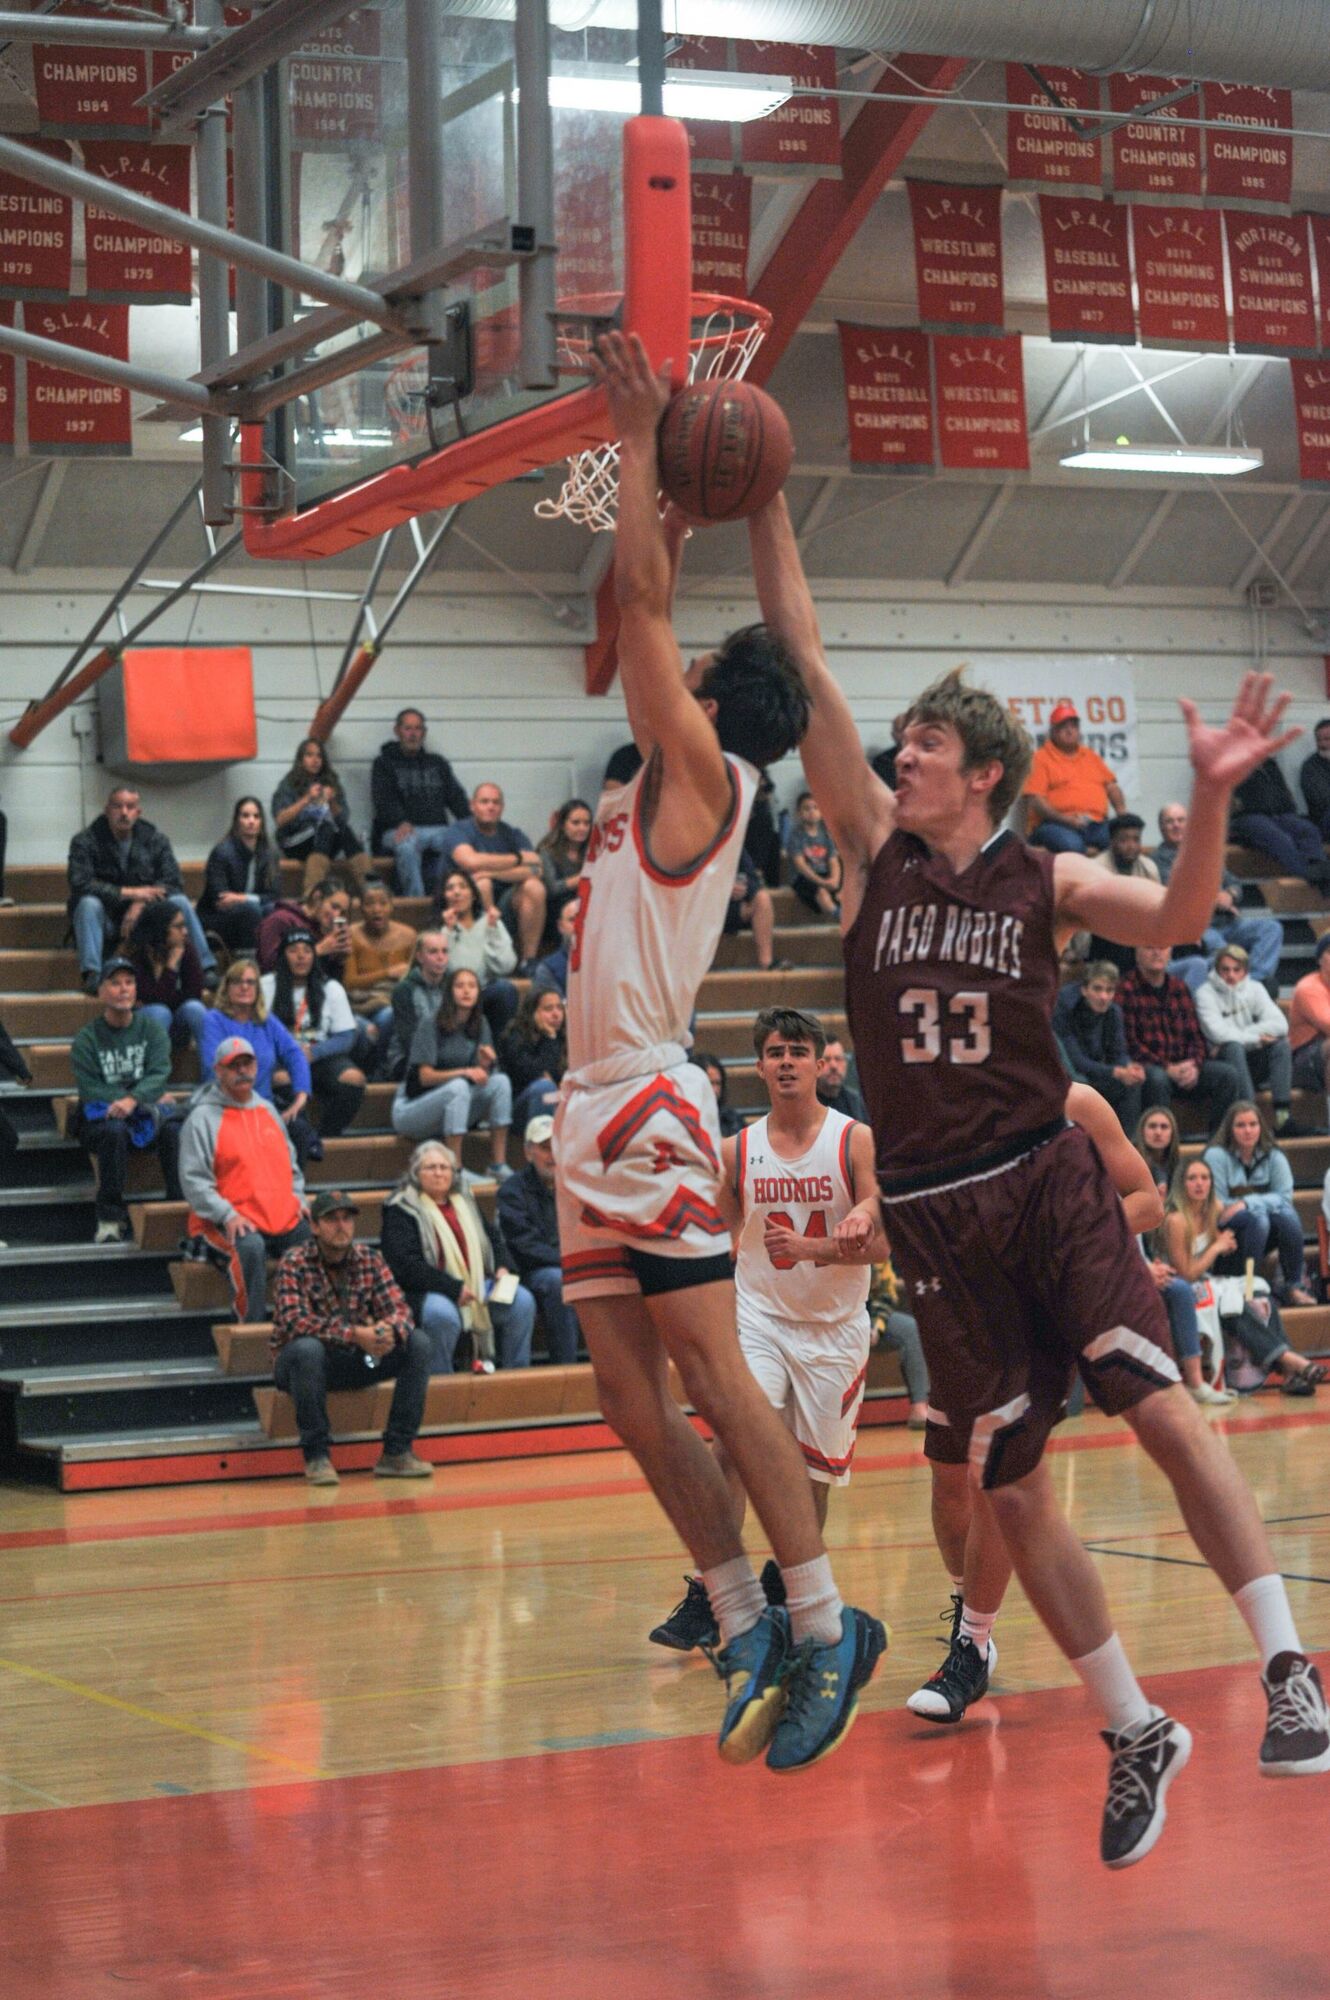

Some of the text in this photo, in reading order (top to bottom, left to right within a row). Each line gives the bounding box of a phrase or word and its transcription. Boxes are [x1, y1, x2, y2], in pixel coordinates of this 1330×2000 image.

[43, 62, 138, 84] CHAMPIONS
[290, 63, 363, 83] COUNTRY
[77, 100, 109, 113] 1984
[766, 108, 832, 125] AMPIONS
[1127, 123, 1187, 143] COUNTRY
[1016, 137, 1096, 158] CHAMPIONS
[1213, 142, 1288, 166] CHAMPIONS
[1120, 147, 1196, 169] CHAMPIONS
[1149, 174, 1175, 187] 1985
[1242, 176, 1266, 189] 1985
[0, 195, 64, 215] ESTLING
[0, 229, 65, 249] AMPIONS
[93, 234, 184, 255] CHAMPIONS
[920, 237, 997, 258] WRESTLING
[1234, 226, 1303, 257] NORTHERN
[1054, 247, 1121, 268] BASEBALL
[3, 262, 33, 275] 1975
[124, 267, 154, 280] 1975
[923, 268, 999, 289] CHAMPIONS
[1145, 261, 1216, 281] SWIMMING
[1239, 267, 1305, 288] SWIMMING
[1053, 278, 1127, 298] CHAMPIONS
[1145, 288, 1220, 310] CHAMPIONS
[1238, 294, 1309, 316] CHAMPIONS
[35, 385, 123, 405] CHAMPIONS
[848, 384, 929, 403] BASKETBALL
[943, 385, 1019, 404] WRESTLING
[854, 412, 929, 431] CHAMPIONS
[945, 416, 1022, 434] CHAMPIONS
[1086, 695, 1127, 725] GO
[873, 904, 1025, 980] PASO ROBLES
[898, 987, 992, 1065] 33
[753, 1175, 835, 1205] HOUNDS
